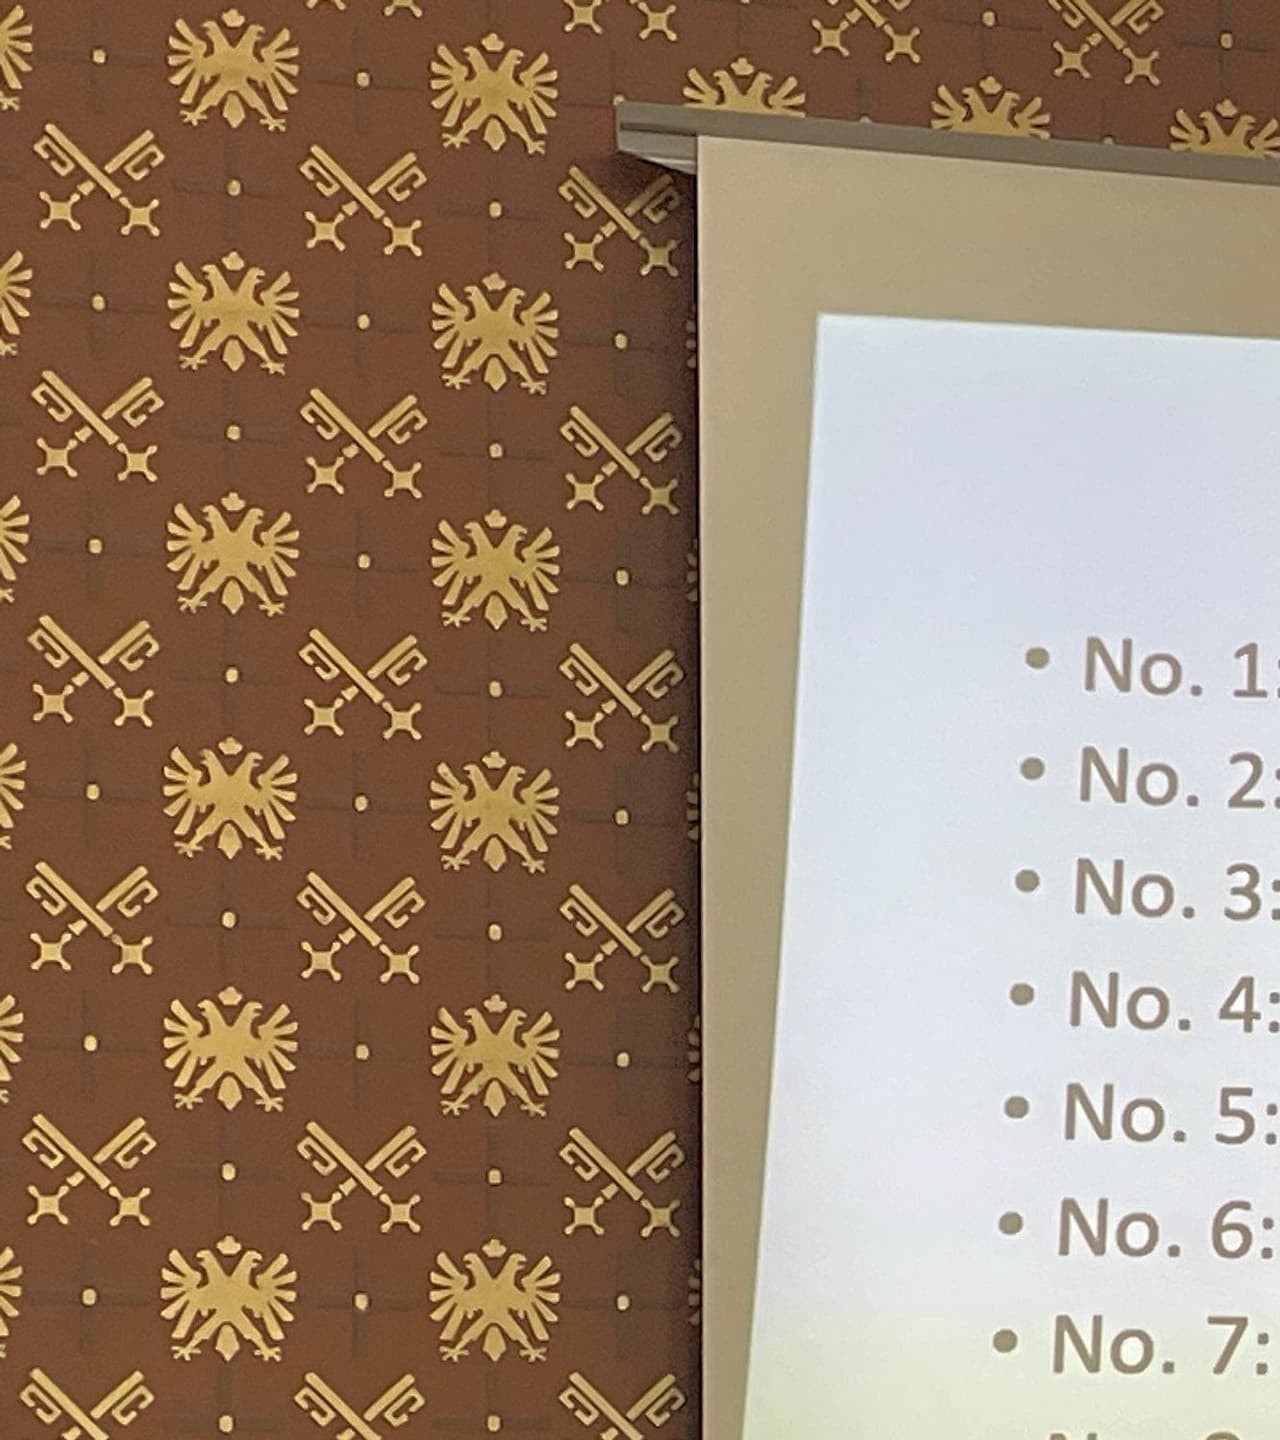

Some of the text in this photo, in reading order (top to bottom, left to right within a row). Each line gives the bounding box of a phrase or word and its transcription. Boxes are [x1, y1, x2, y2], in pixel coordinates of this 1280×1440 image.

[1085, 637, 1203, 697] No.
[1080, 746, 1199, 807] No.
[1075, 858, 1195, 919] No.
[1070, 971, 1191, 1031] No.
[1218, 976, 1280, 1033] 4:
[1065, 1083, 1186, 1143] No.
[1215, 1087, 1278, 1145] 5:
[1059, 1198, 1181, 1258] No.
[1212, 1200, 1274, 1259] 6:
[1053, 1315, 1175, 1374] No.
[1207, 1316, 1270, 1375] 7:
